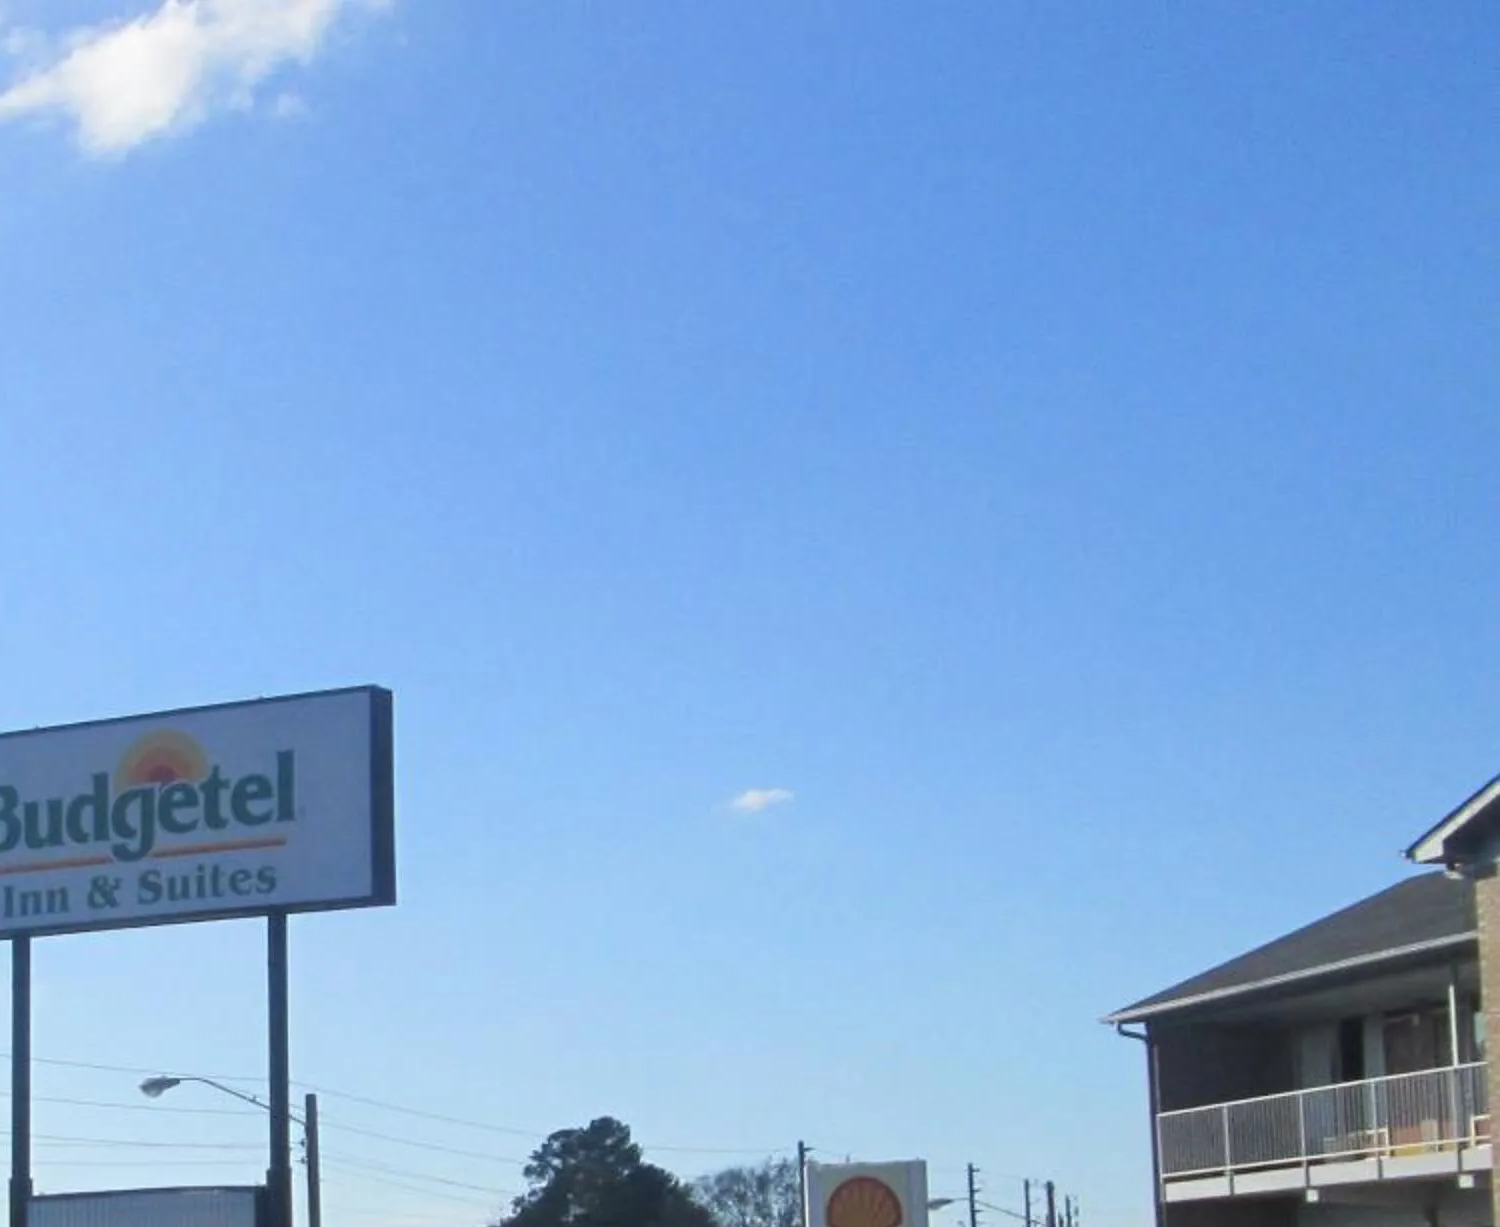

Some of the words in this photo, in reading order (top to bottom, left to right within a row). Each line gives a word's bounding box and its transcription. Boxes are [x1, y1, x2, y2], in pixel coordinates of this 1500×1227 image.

[3, 883, 70, 919] Inn
[86, 875, 124, 909] &
[137, 863, 278, 906] Suites
